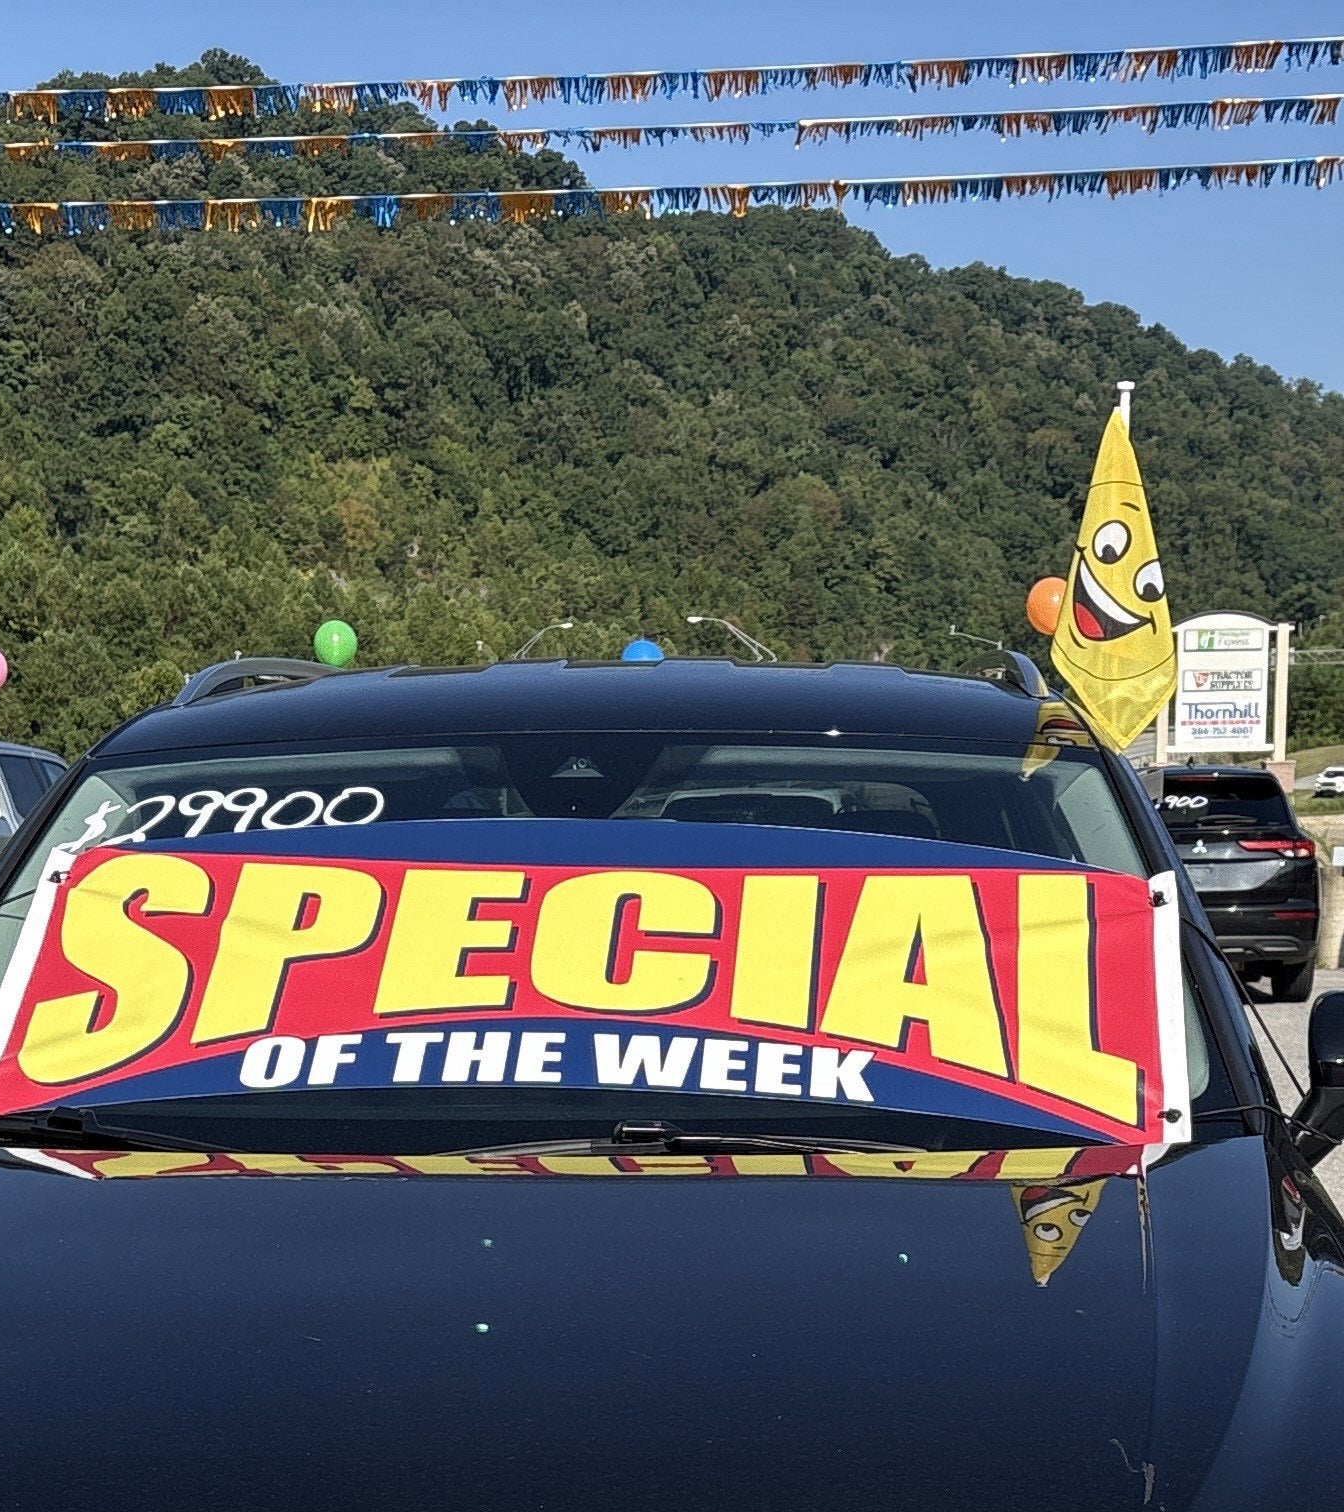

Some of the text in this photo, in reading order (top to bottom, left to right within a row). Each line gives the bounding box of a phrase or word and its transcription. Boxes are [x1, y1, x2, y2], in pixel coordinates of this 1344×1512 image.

[1182, 702, 1260, 719] Thornhill
[17, 853, 1145, 1132] SPECIAL
[239, 1031, 877, 1103] OF THE WEEK
